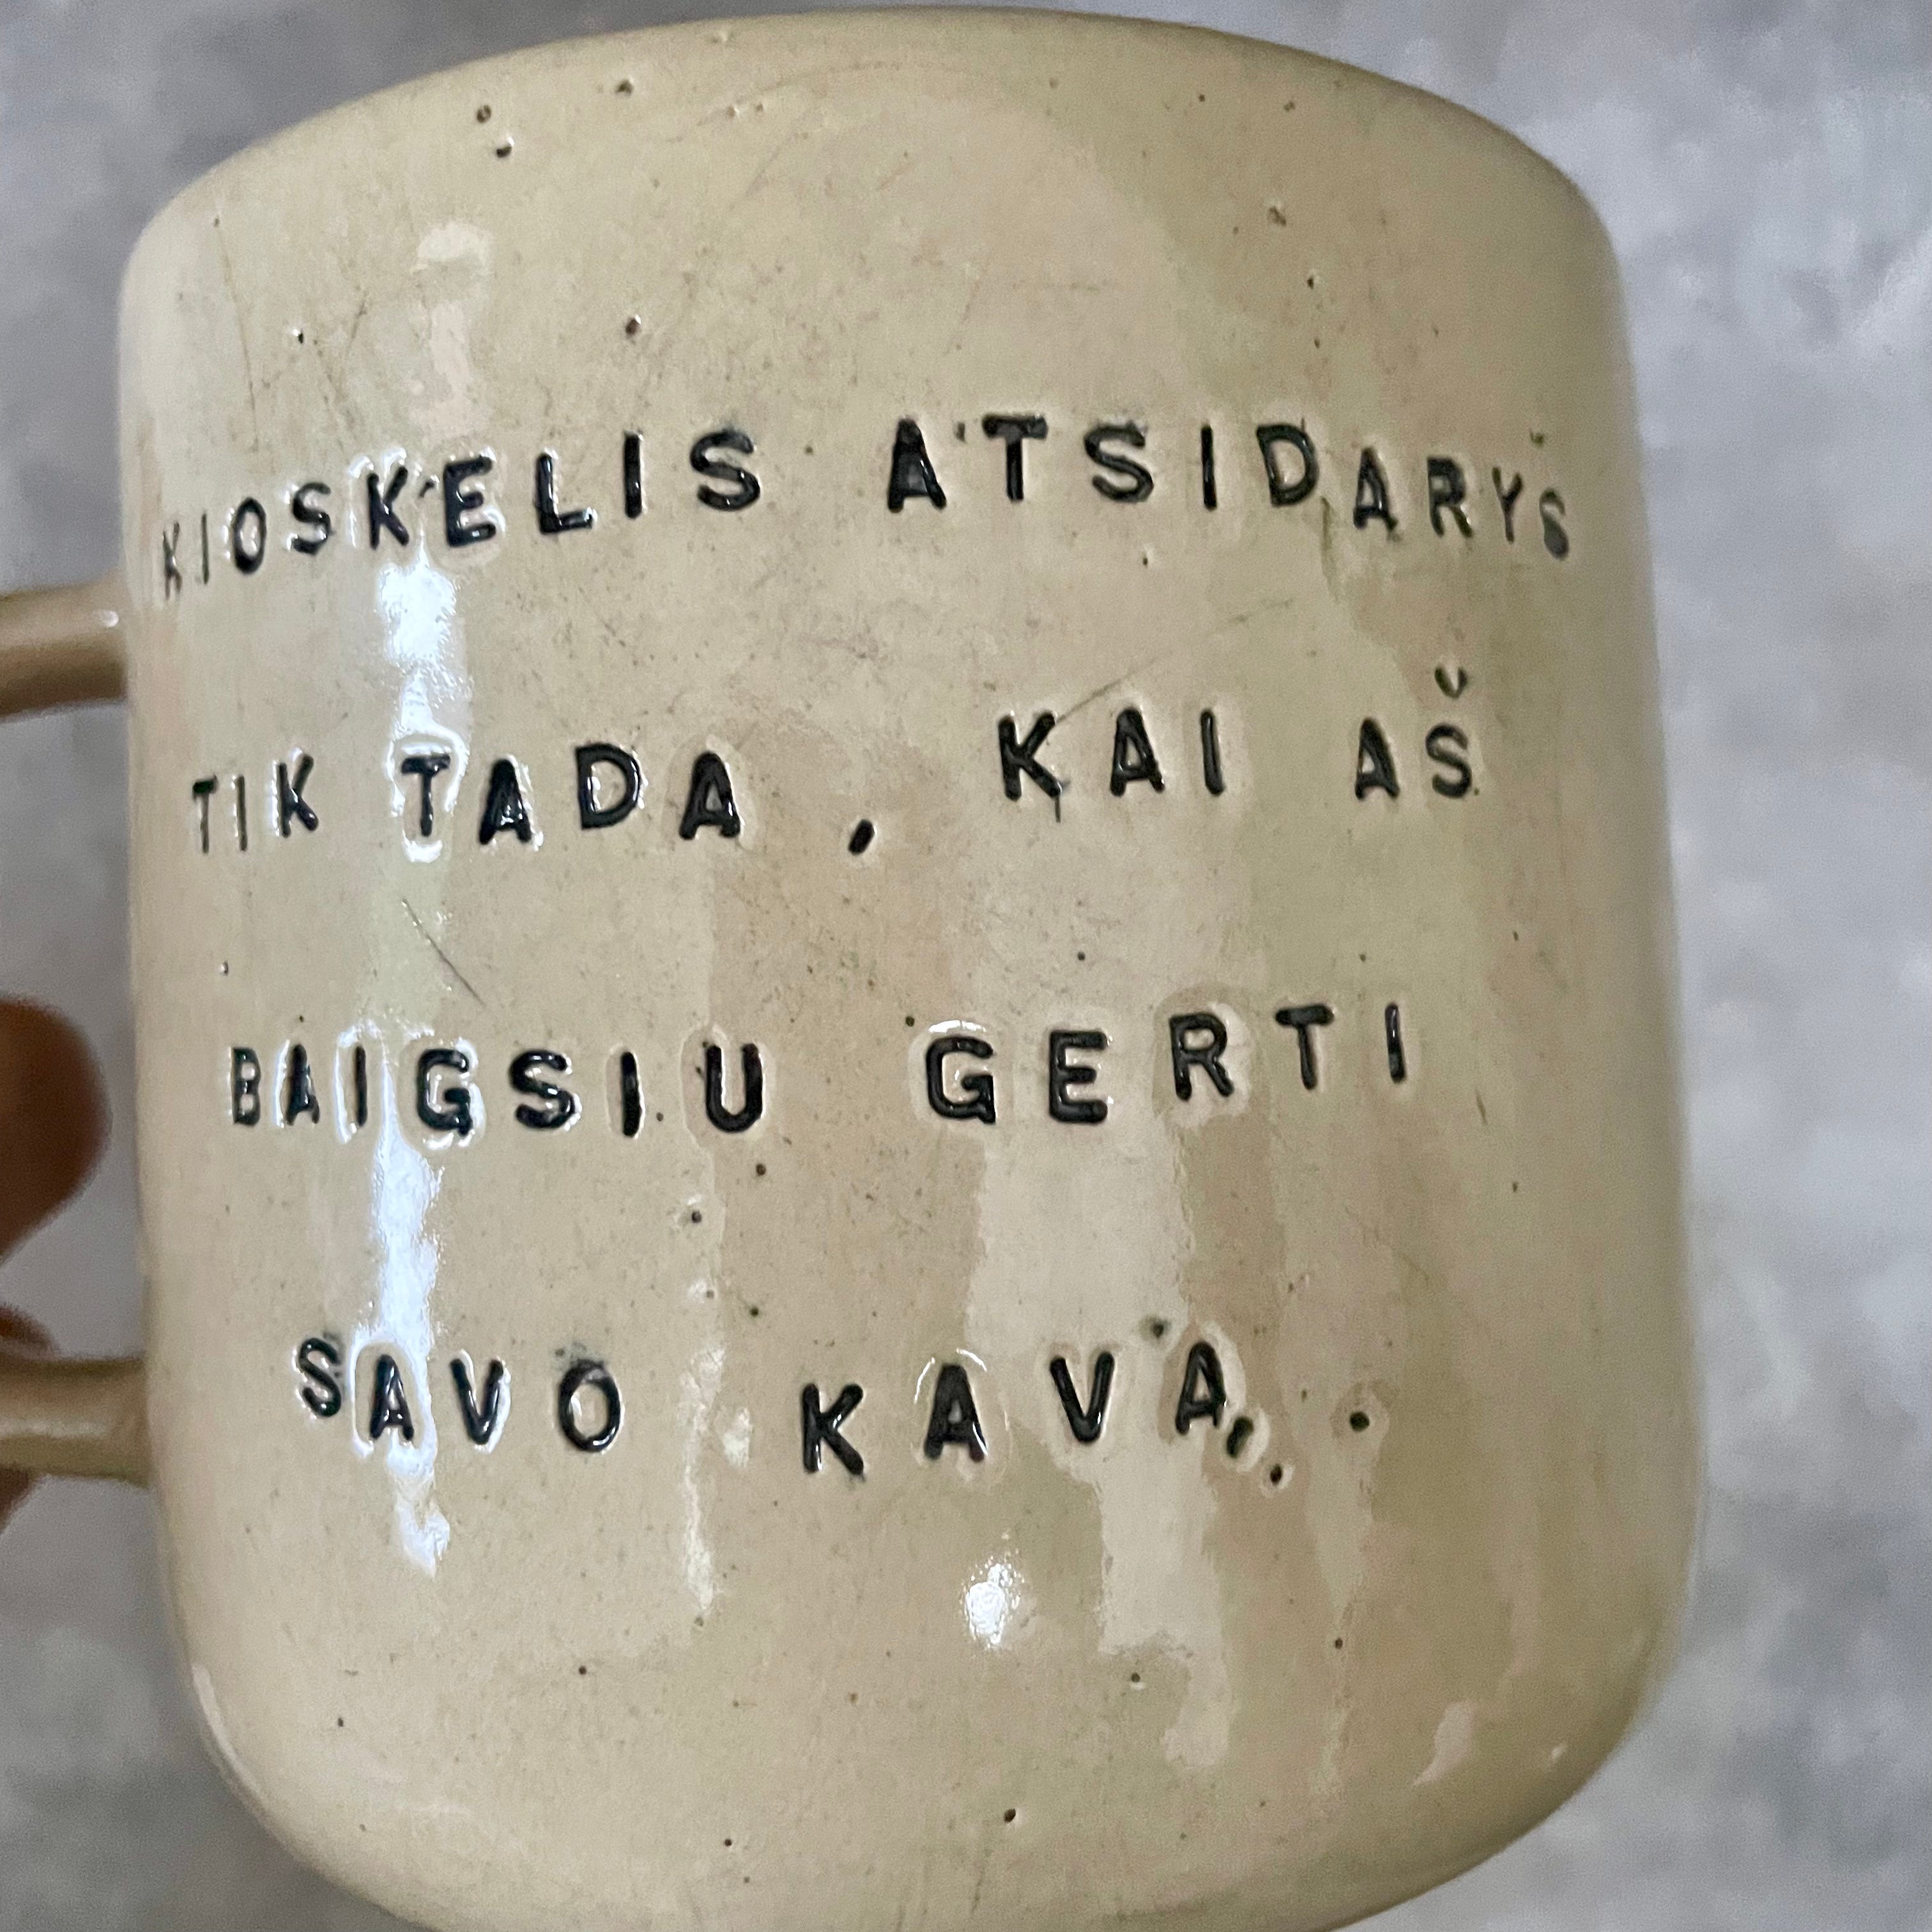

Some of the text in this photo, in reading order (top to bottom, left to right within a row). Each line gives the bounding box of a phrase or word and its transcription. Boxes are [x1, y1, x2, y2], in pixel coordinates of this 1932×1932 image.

[162, 414, 1569, 599] KIOSKELIS ATSIDARYS
[192, 753, 319, 854] TIK
[997, 708, 1225, 802] KAI
[231, 1003, 1407, 1138] BAIGSIU GERTI
[298, 1337, 621, 1453] SAVO
